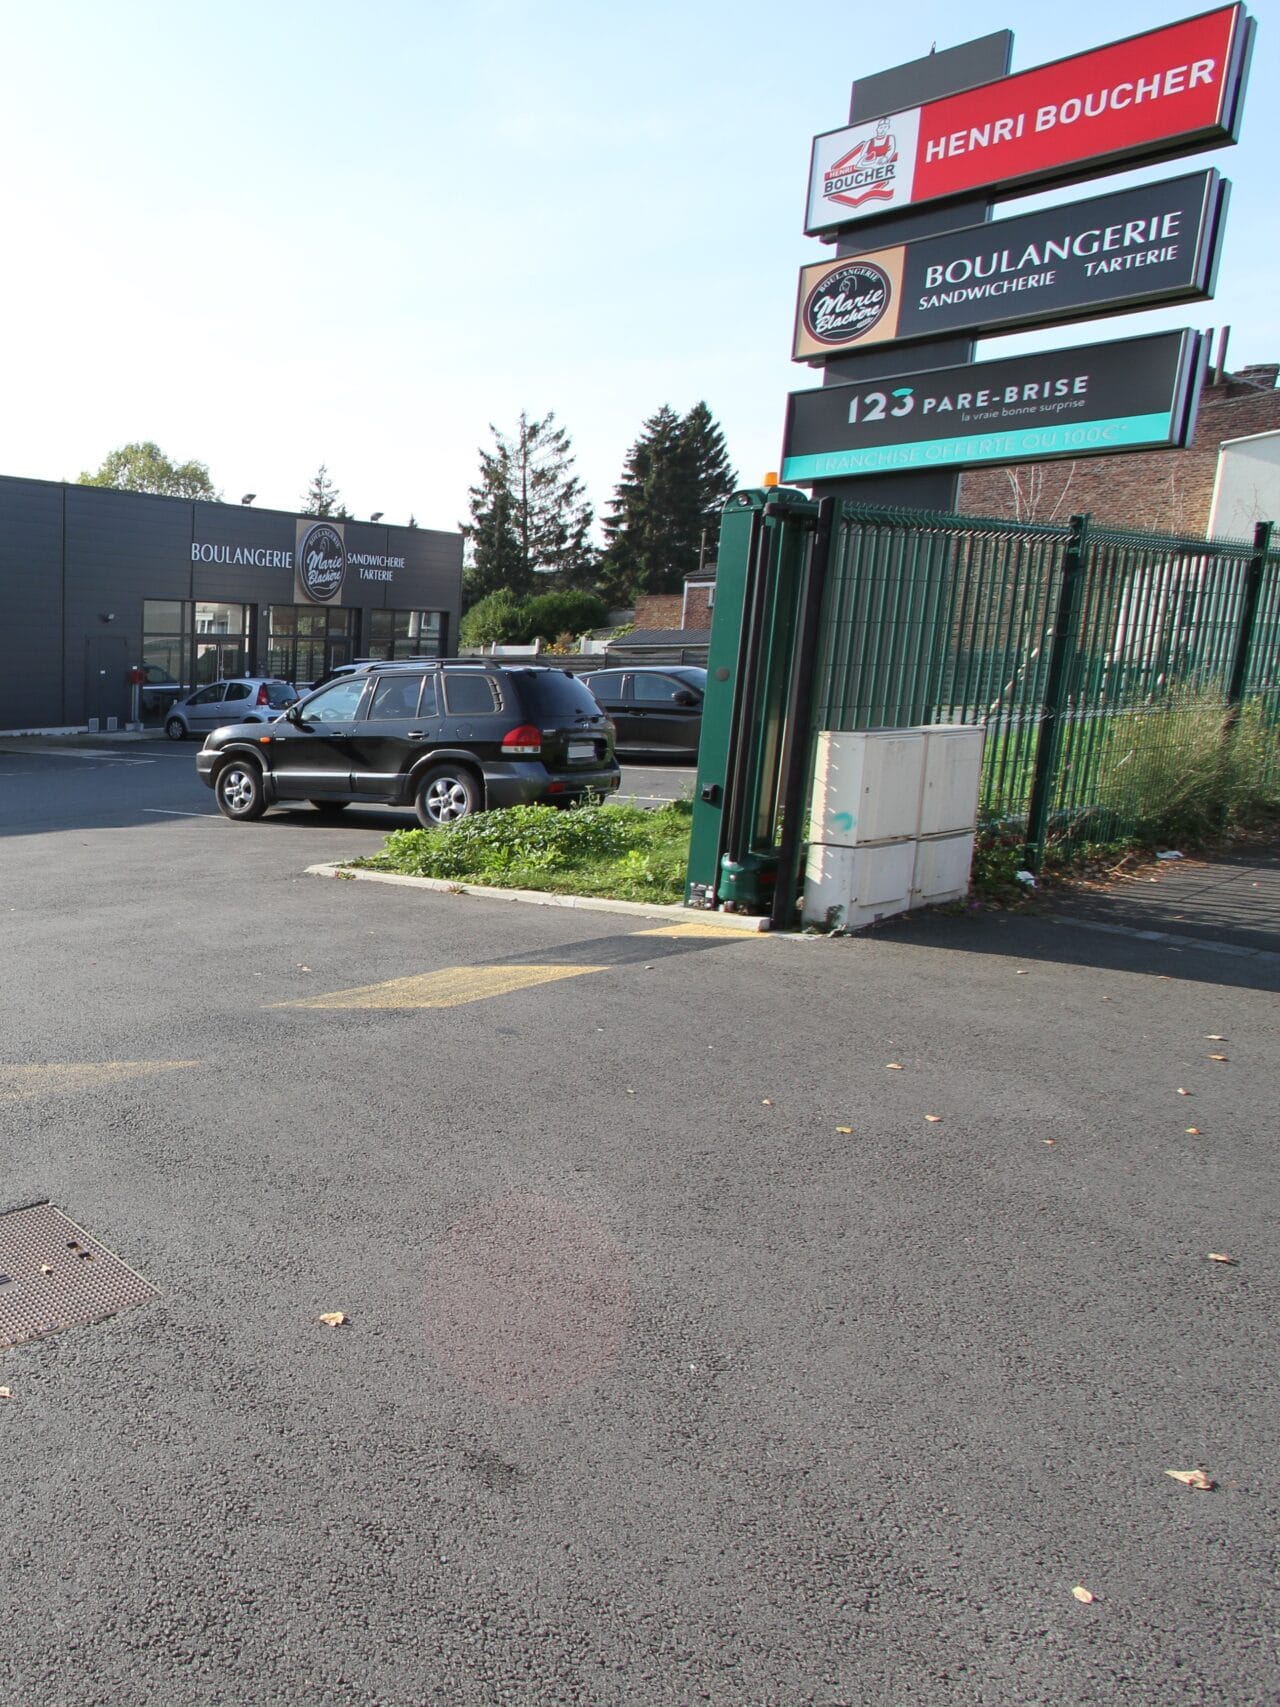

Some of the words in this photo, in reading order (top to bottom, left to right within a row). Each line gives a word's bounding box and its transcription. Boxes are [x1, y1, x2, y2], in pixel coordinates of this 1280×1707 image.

[925, 113, 1025, 164] HENRI
[1035, 58, 1216, 133] BOUCHER
[824, 164, 895, 193] BOUCHER
[925, 211, 1183, 289] BOULANGERIE
[818, 268, 881, 293] BOULANGERIE
[918, 271, 1056, 310] SANDWICHERIE
[1084, 245, 1179, 277] TARTERIE
[813, 289, 883, 319] Marie
[815, 305, 881, 333] Blachère
[847, 387, 916, 424] 123
[922, 375, 1090, 415] PARE-BRISE
[962, 412, 970, 422] la
[973, 409, 999, 420] vraie
[1002, 405, 1037, 417] bonne
[1039, 399, 1086, 413] surprise
[816, 450, 918, 472] FRANCHISE
[924, 437, 1016, 460] OFFERTE
[1021, 431, 1057, 449] OU
[191, 542, 293, 569] BOULANGERIE
[307, 550, 342, 571] Marie
[347, 552, 406, 569] SANDWICHERIE
[307, 569, 341, 586] Blachère
[359, 568, 394, 582] TARTERIE
